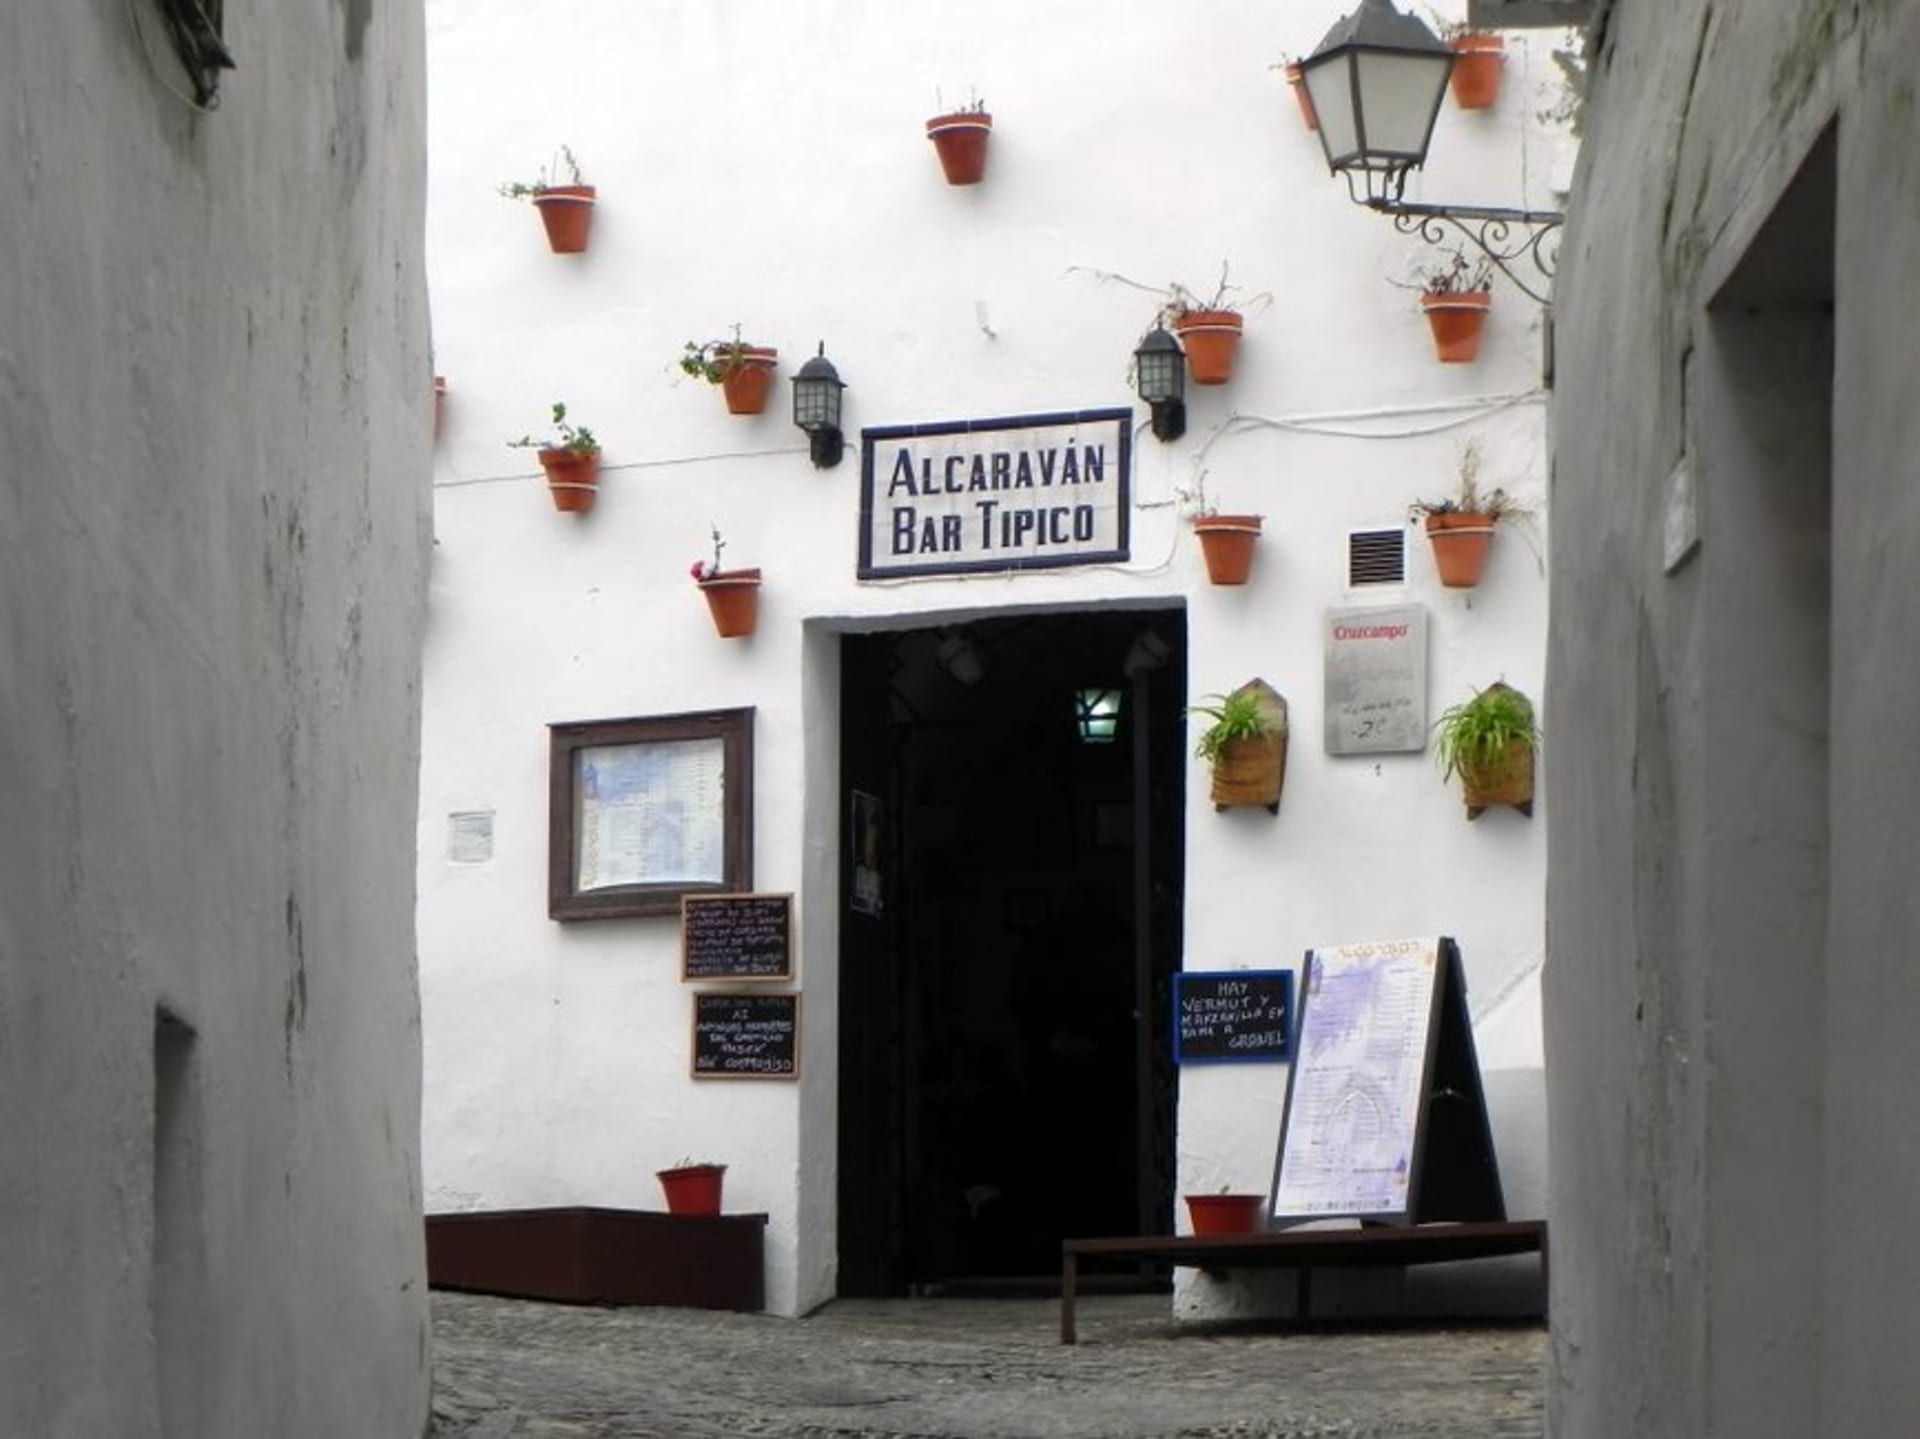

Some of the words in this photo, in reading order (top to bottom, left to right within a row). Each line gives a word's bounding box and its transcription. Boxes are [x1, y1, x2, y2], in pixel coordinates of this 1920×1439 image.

[888, 438, 1105, 498] ALCARAVÁN
[892, 505, 962, 555] BAR
[975, 500, 1094, 550] TIPICO
[1217, 981, 1249, 996] HAY
[1182, 996, 1251, 1012] VERMUT
[1260, 994, 1271, 1007] Y
[1224, 1024, 1233, 1035] A
